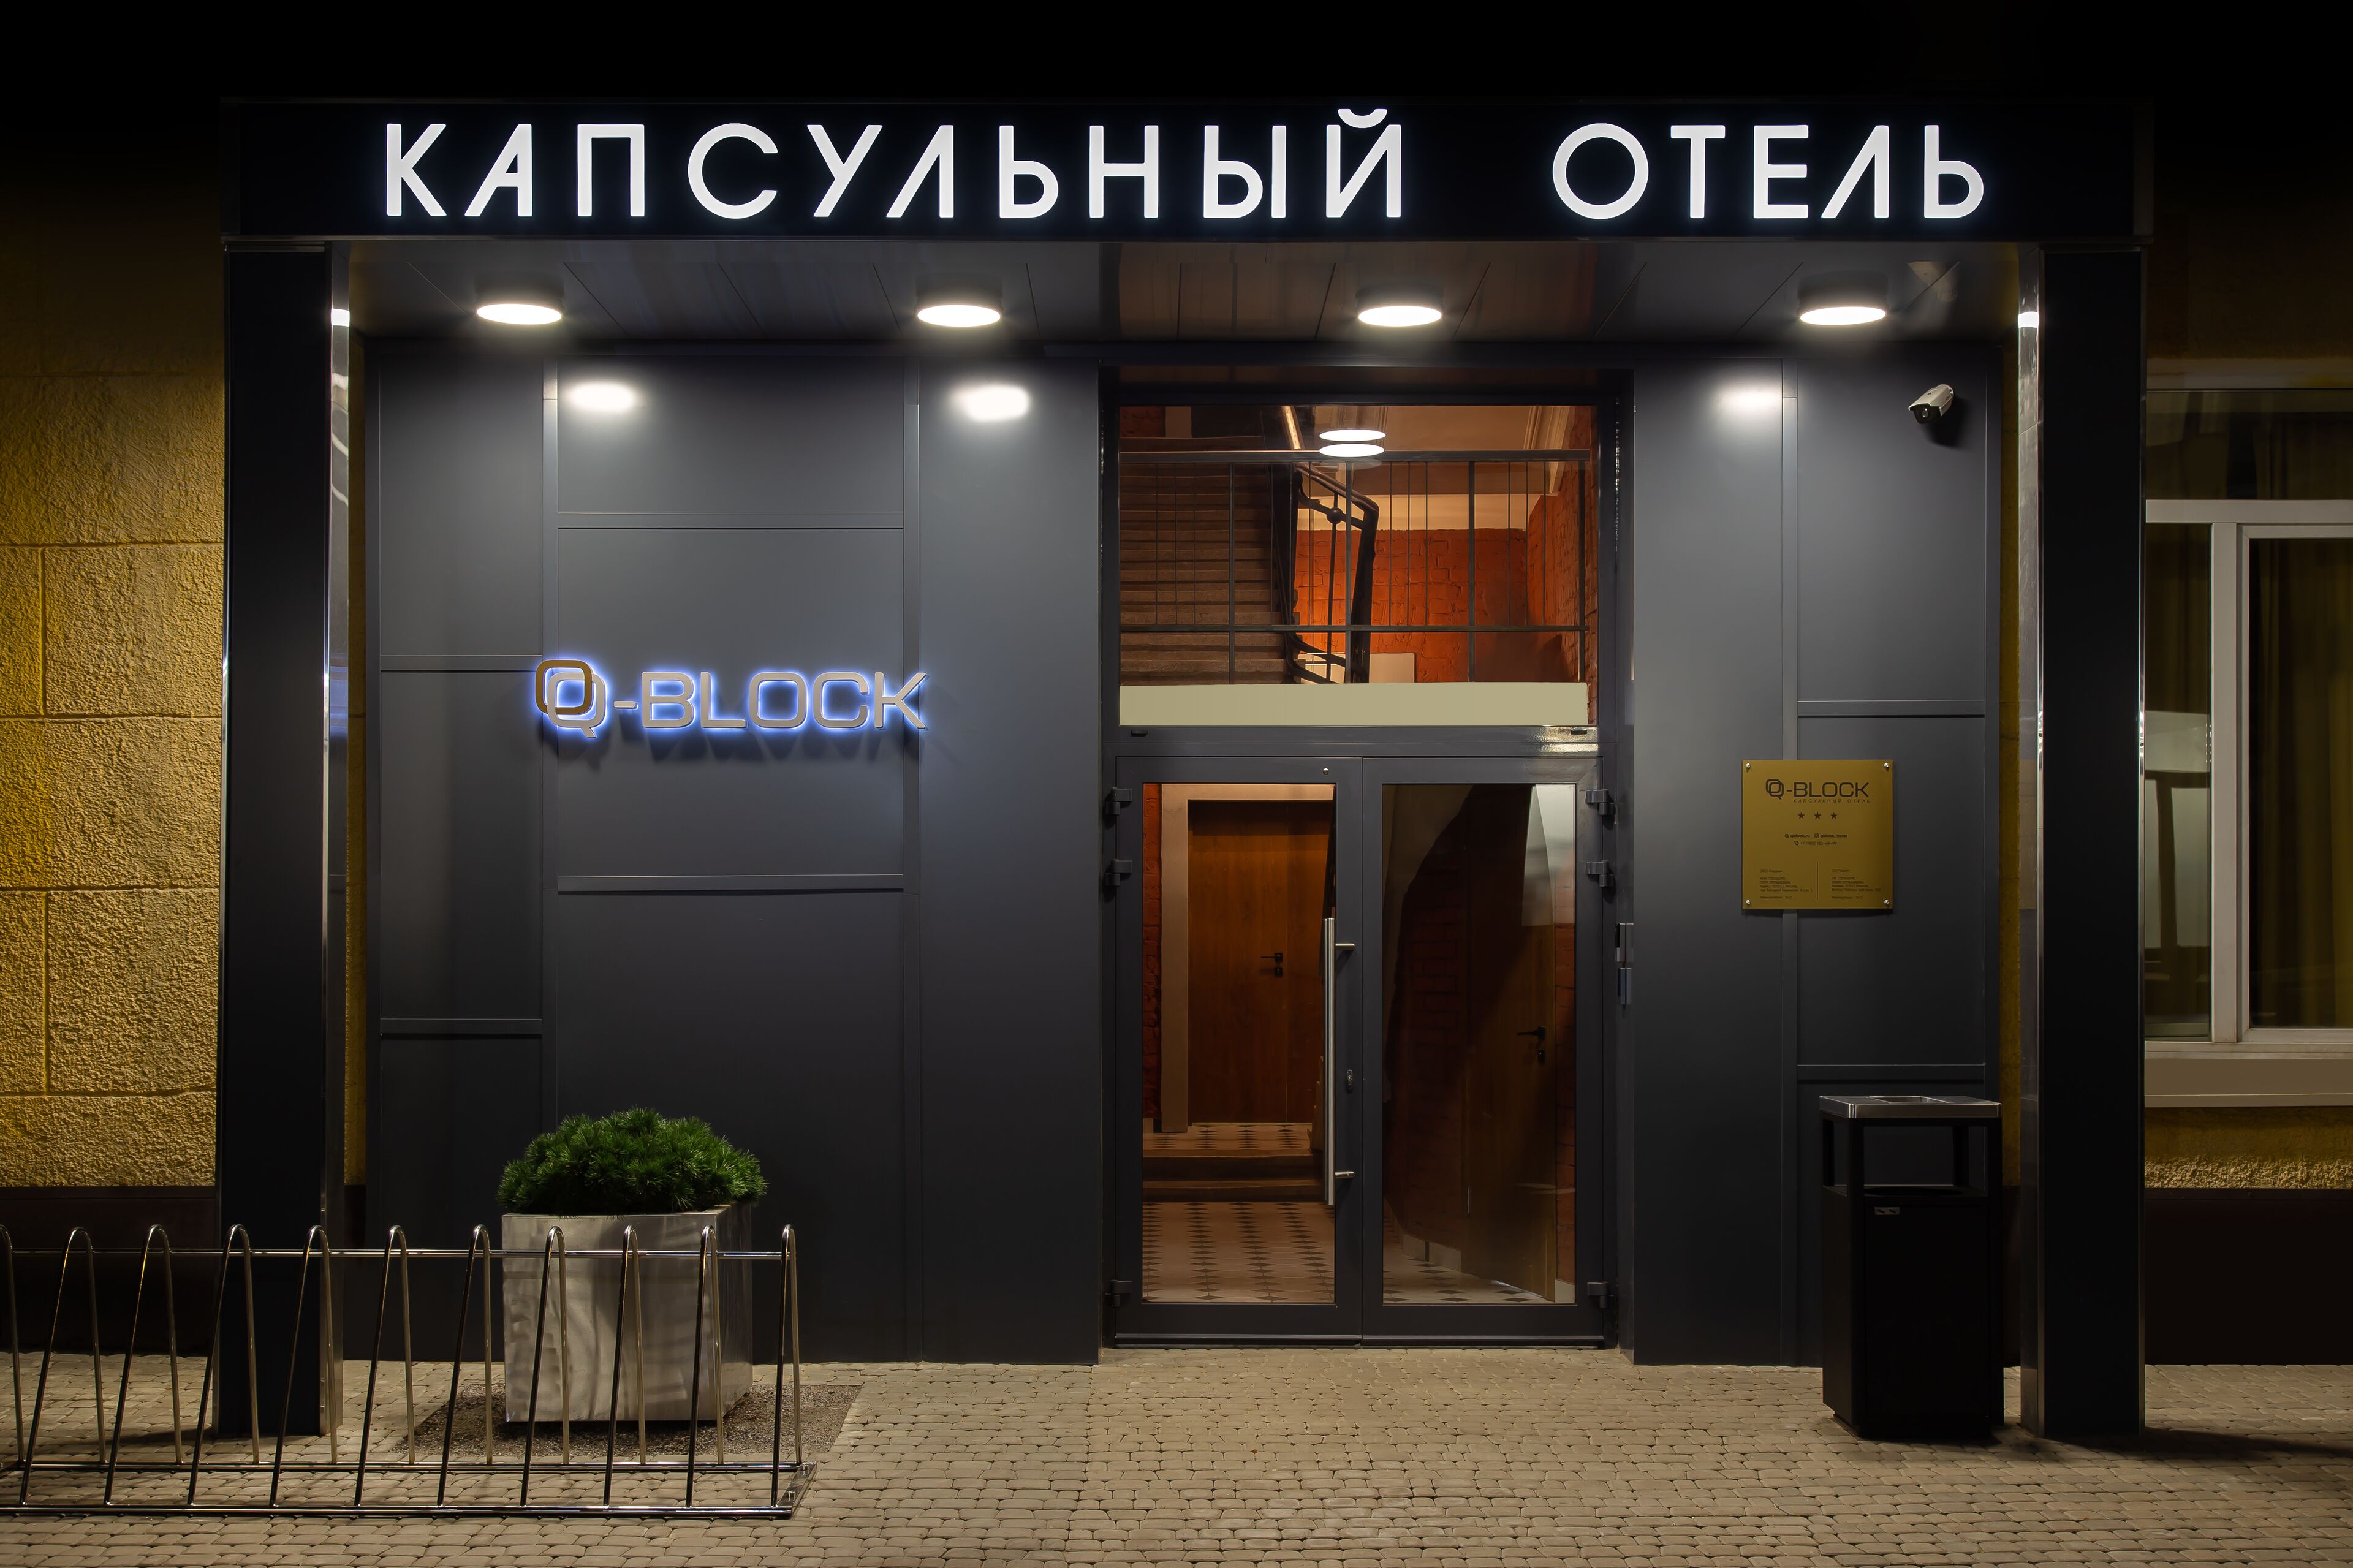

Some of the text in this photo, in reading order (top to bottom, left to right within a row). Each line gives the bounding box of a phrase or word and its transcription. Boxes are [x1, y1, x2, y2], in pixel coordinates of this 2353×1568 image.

[387, 108, 1984, 219] КАПСУЛЬНЫЙ ОТЕЛЬ
[536, 659, 927, 738] Q-BLOCK
[1765, 779, 1870, 800] Q-BLOCK
